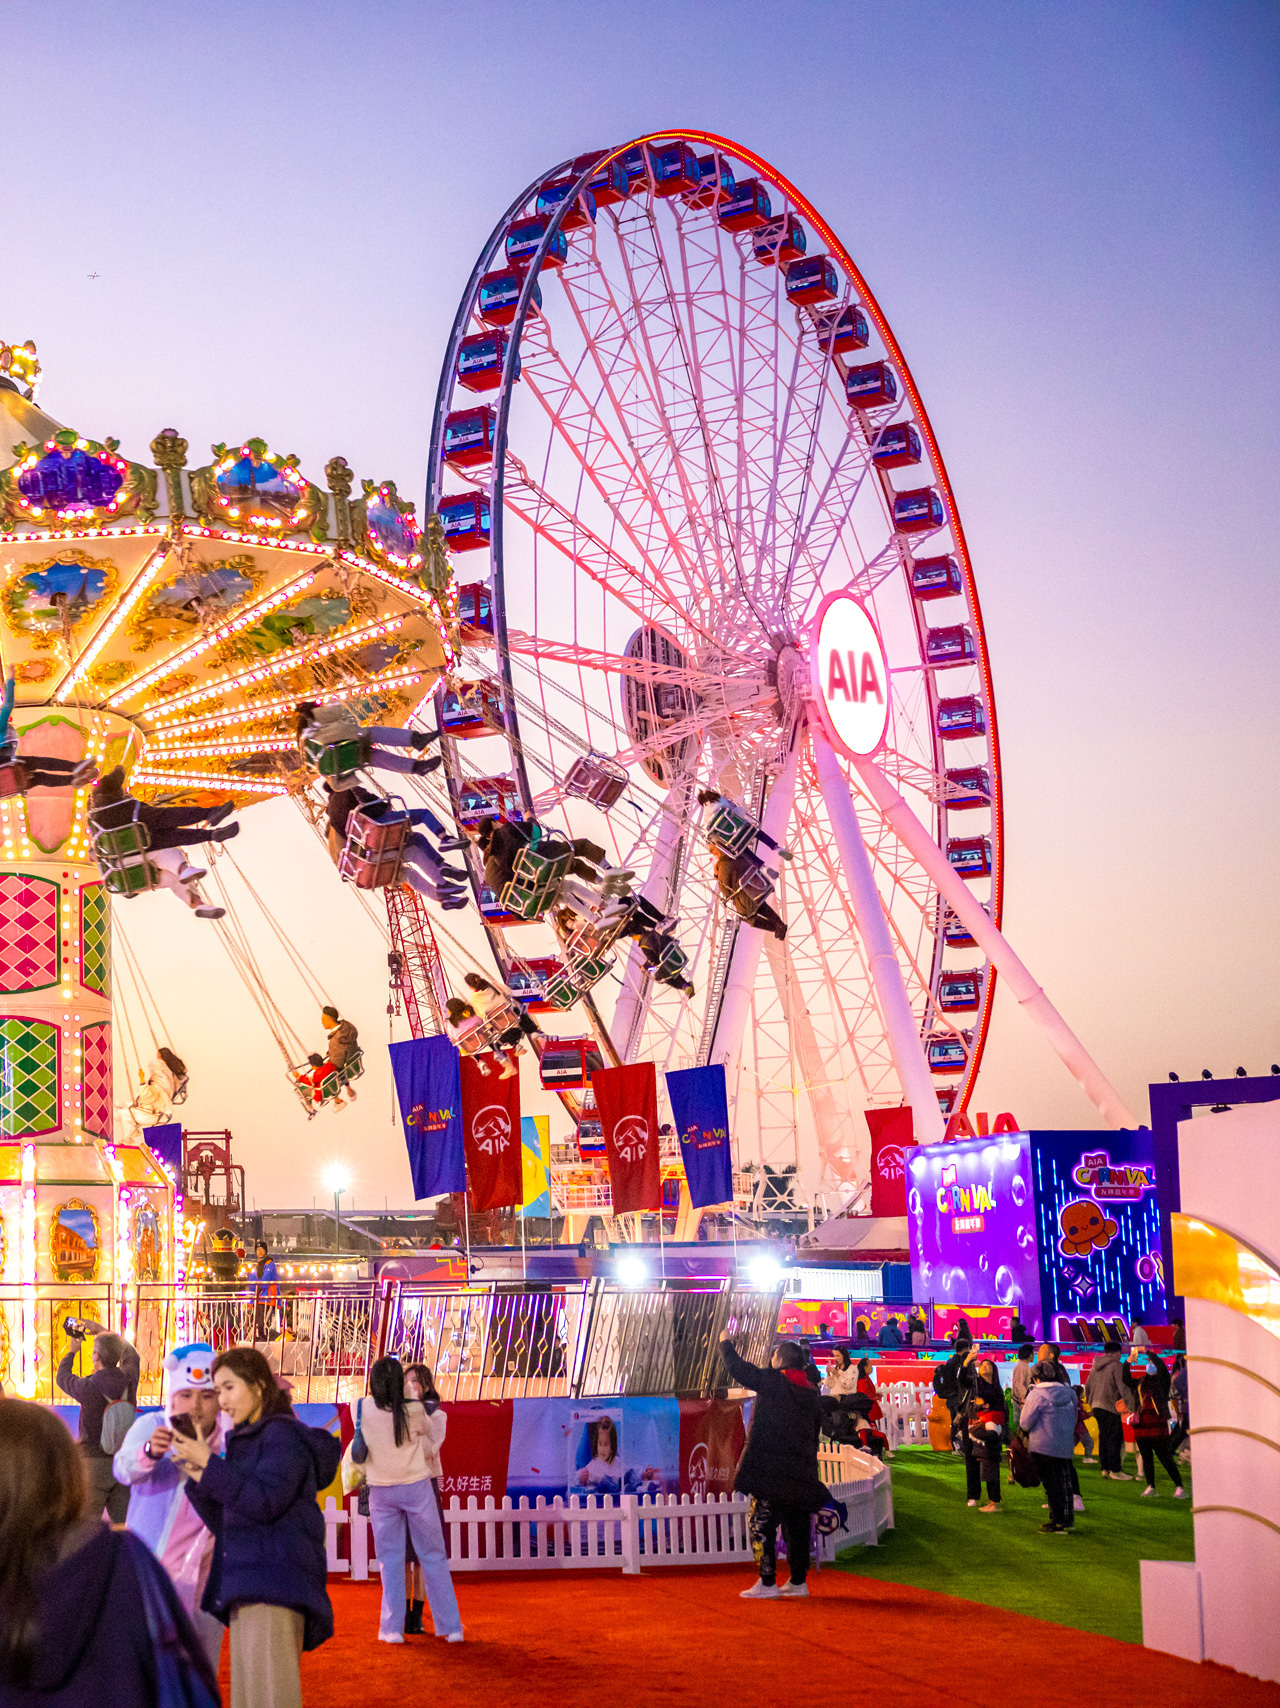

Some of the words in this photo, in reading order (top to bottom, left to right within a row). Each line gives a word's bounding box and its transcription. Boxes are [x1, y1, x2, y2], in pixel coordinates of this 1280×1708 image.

[827, 648, 884, 705] AIA
[412, 1105, 424, 1113] AIA
[943, 1112, 1020, 1142] AIA
[478, 1135, 510, 1155] AIA
[619, 1143, 646, 1162] AIA
[1088, 1158, 1104, 1167] AIA
[880, 1166, 904, 1180] AIA
[1077, 1168, 1156, 1187] CARNIVAL
[937, 1182, 996, 1215] CARNIVAL
